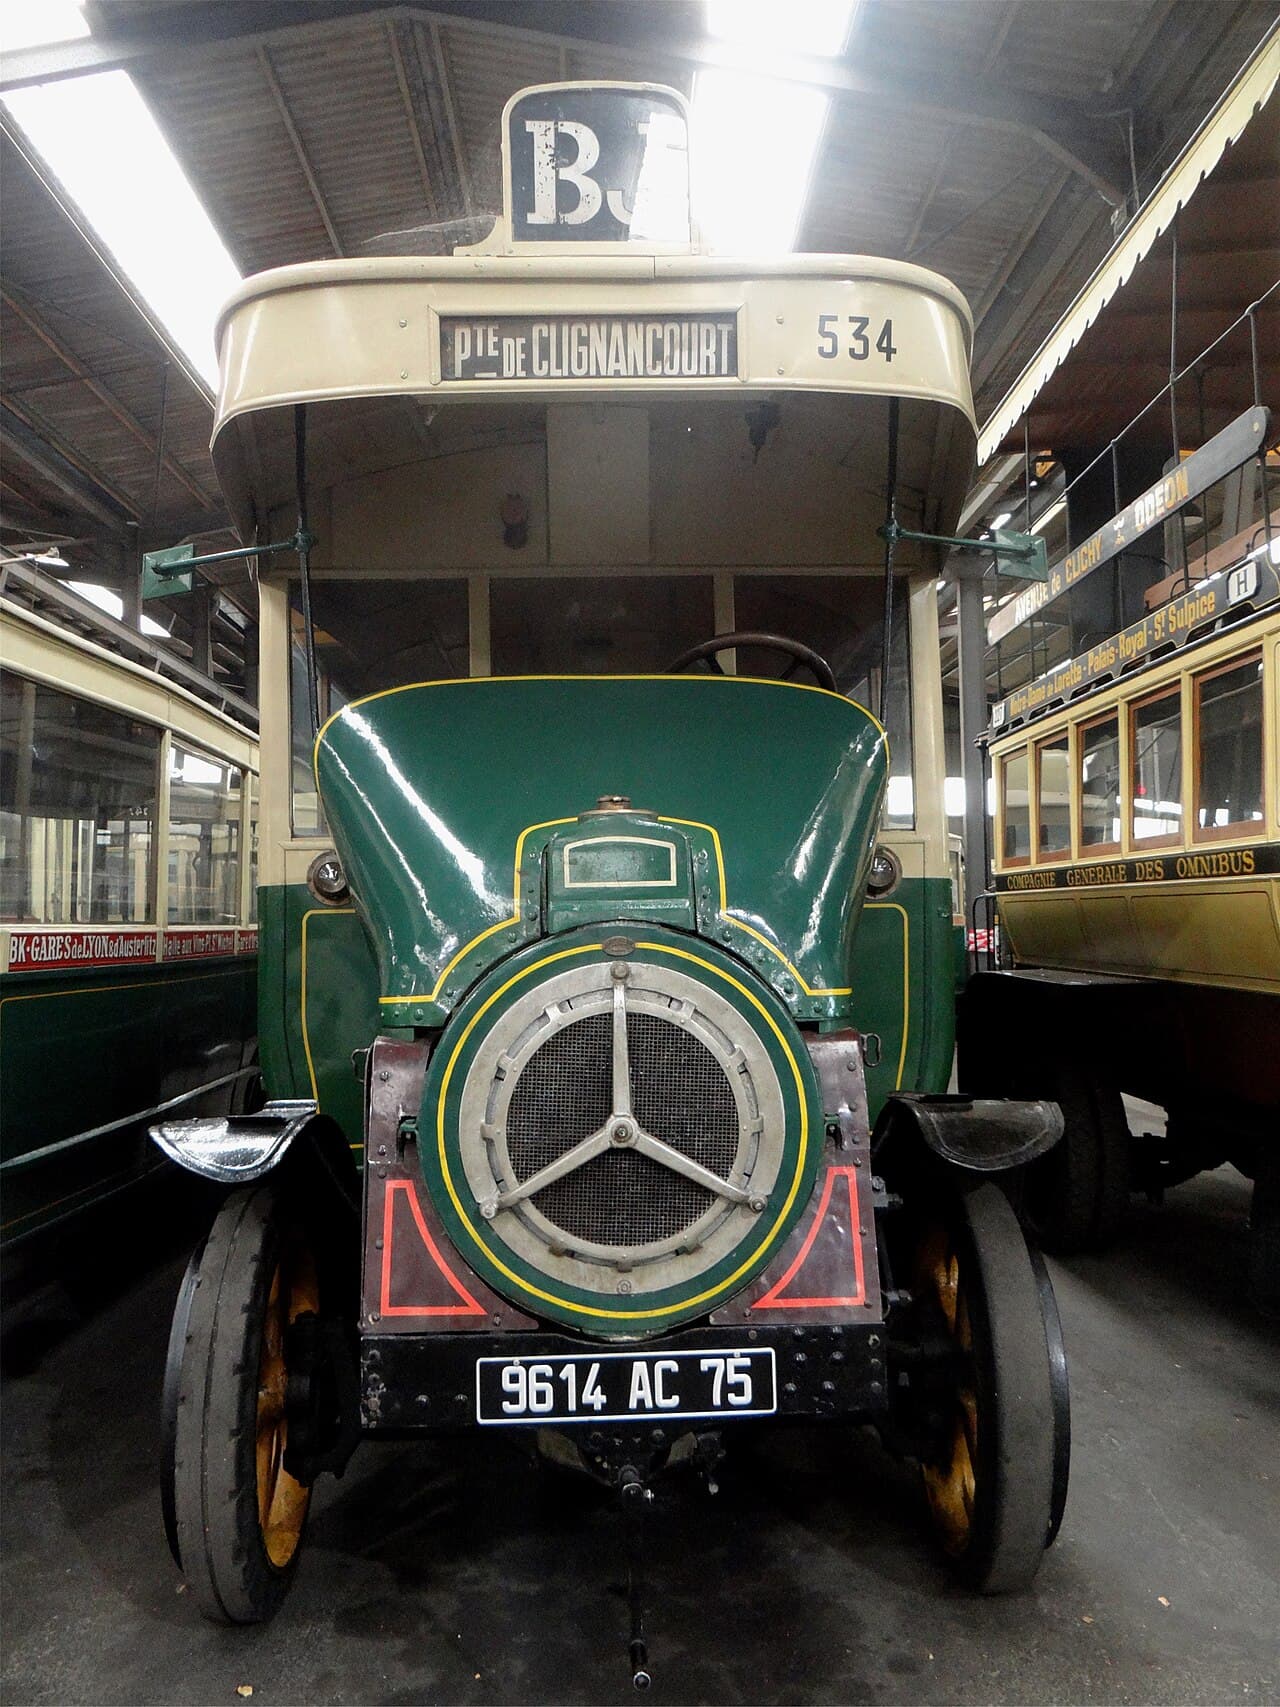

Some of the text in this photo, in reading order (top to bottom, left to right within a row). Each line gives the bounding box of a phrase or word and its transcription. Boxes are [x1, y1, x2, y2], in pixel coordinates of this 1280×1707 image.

[502, 336, 527, 378] DE
[531, 321, 733, 378] CLIGNANCOURT
[817, 313, 898, 362] 534
[1065, 535, 1103, 583] CLICHY
[1135, 467, 1189, 530] ODEON
[1236, 569, 1248, 597] H
[1168, 590, 1215, 634] Sulpice
[1007, 850, 1255, 891] COMPAGNIE GENERALE DES OMNIBUS
[501, 1356, 752, 1414] 9614 AC 75
